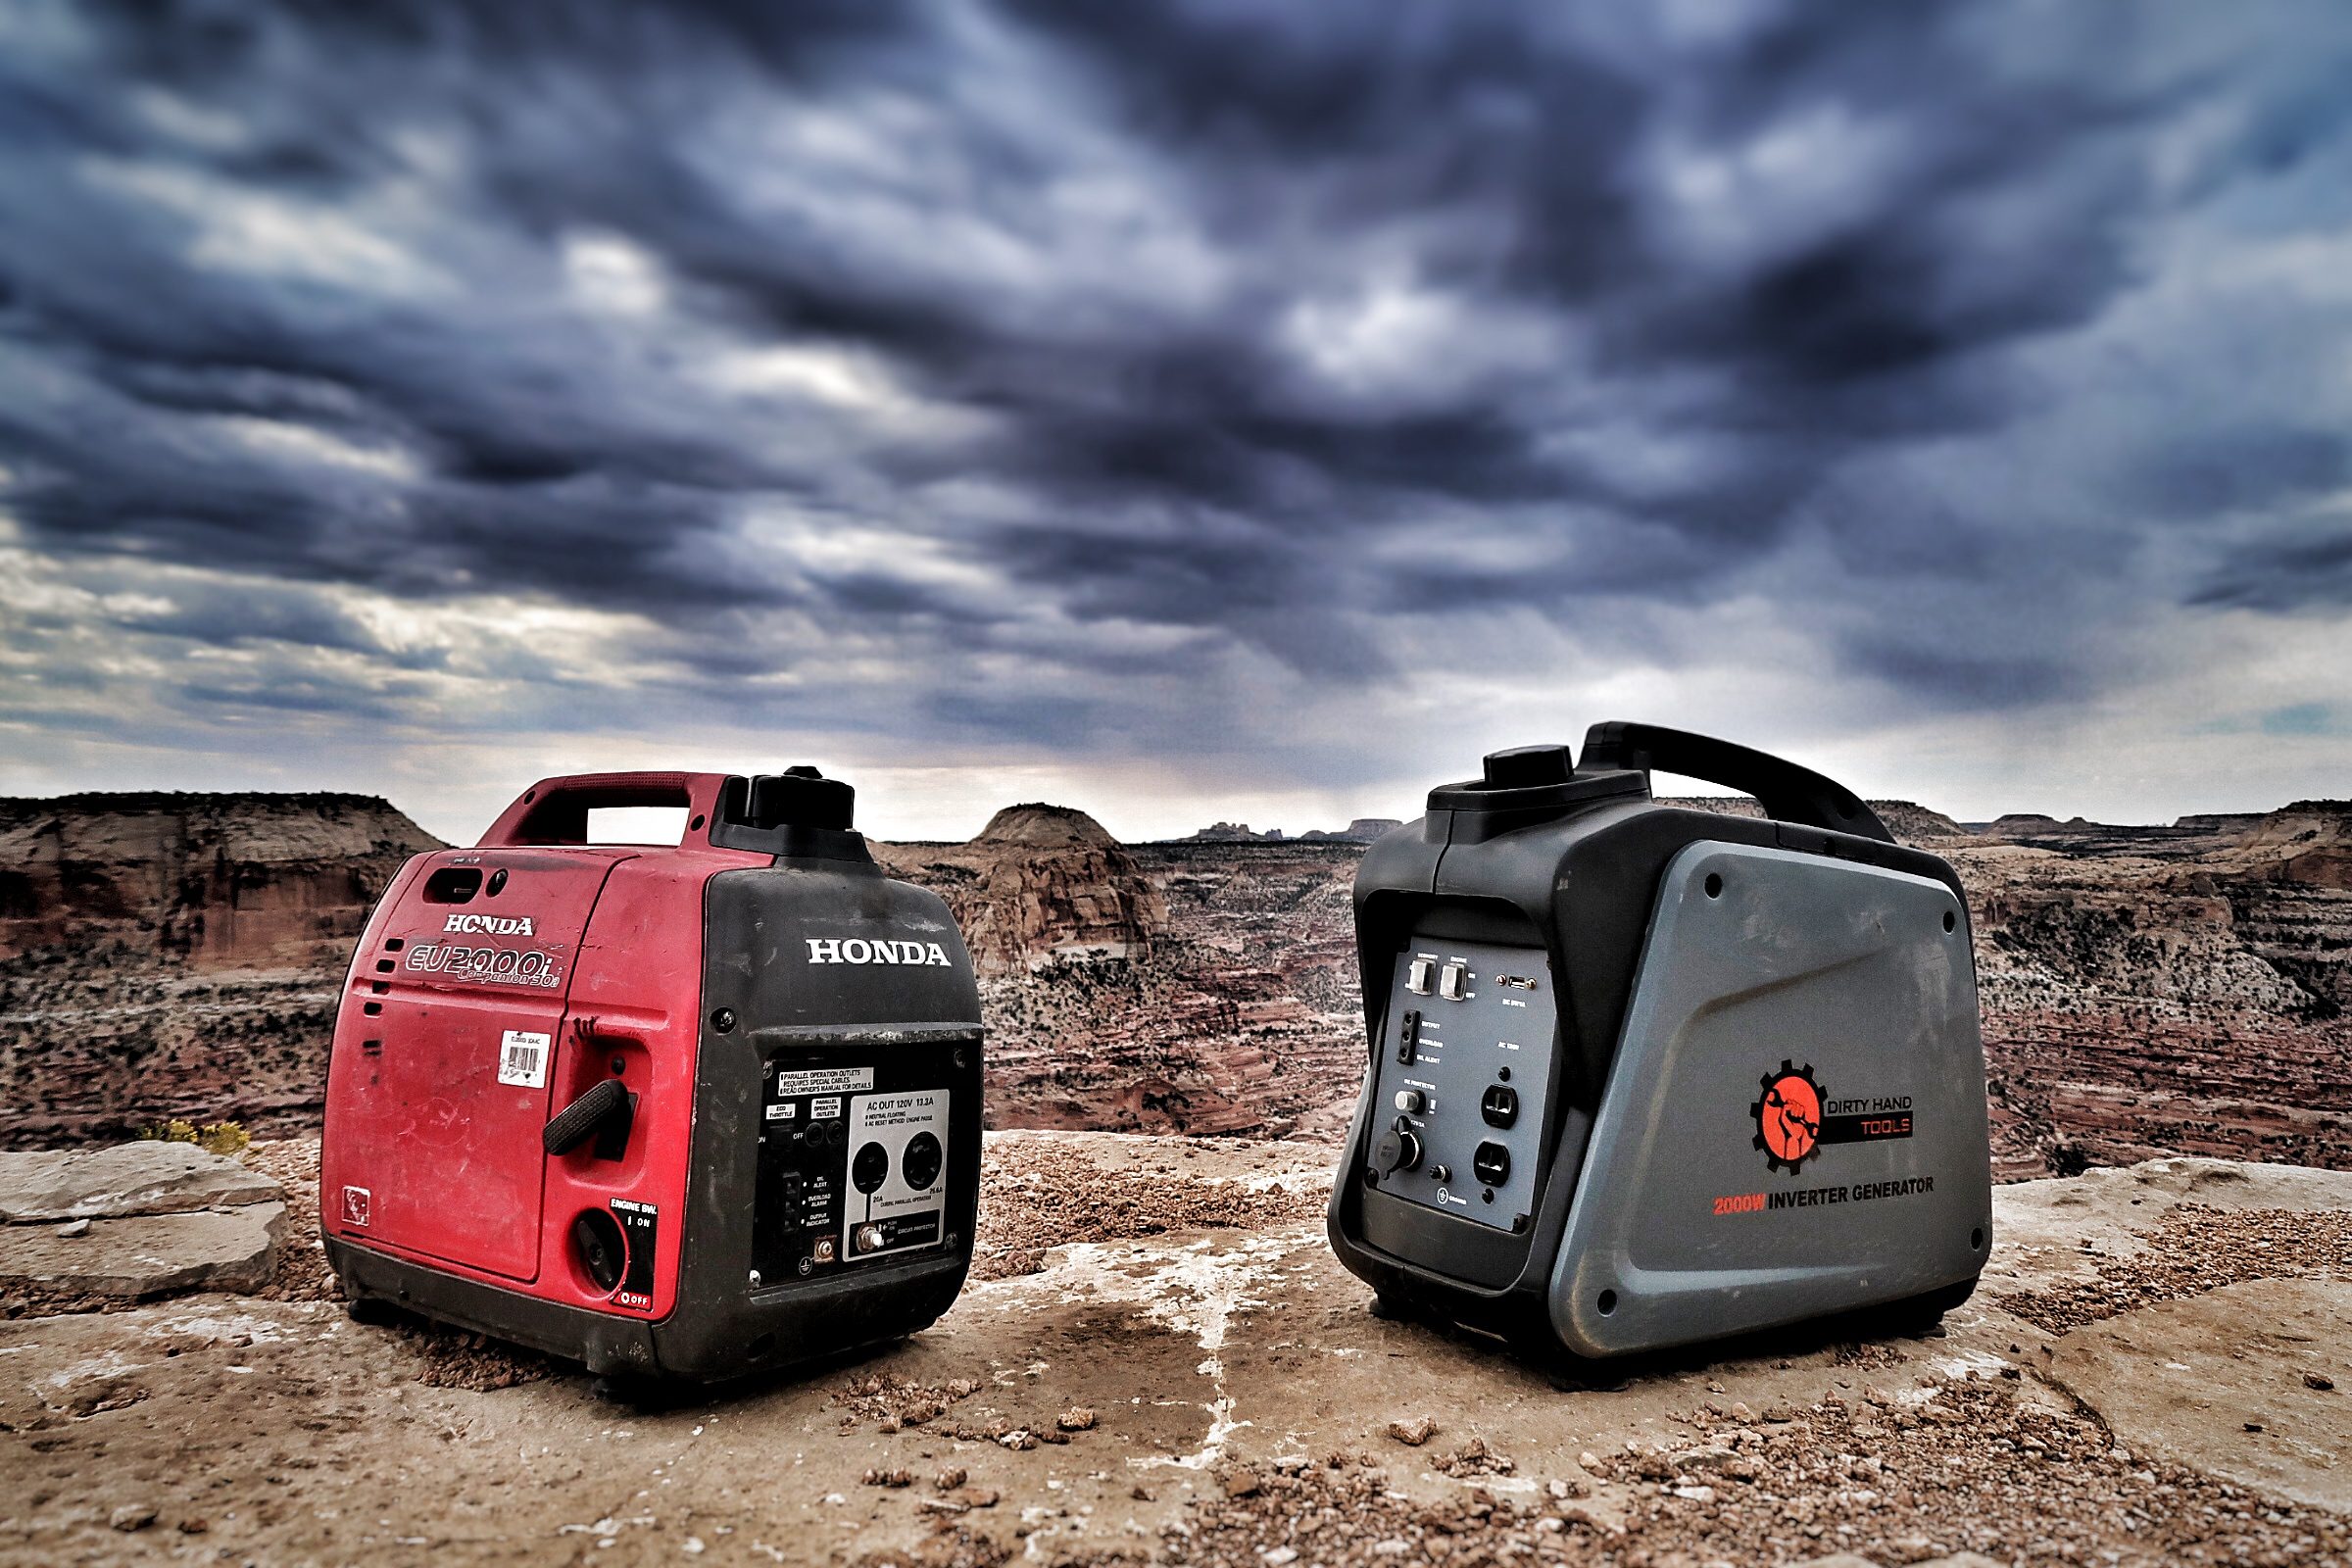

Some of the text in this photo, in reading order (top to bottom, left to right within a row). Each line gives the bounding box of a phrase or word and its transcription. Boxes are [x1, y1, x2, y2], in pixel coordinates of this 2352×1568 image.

[443, 913, 534, 937] HONDA
[805, 938, 953, 967] HONDA
[809, 1070, 839, 1079] OPERATION
[866, 1102, 878, 1111] AC
[878, 1100, 895, 1109] OUT
[896, 1098, 913, 1108] 120V
[1828, 1096, 1912, 1114] DIRTY HAND
[1861, 1118, 1910, 1135] TOOLS
[1713, 1176, 1935, 1216] 2000W INVERTER GENERATOR
[611, 1198, 641, 1212] ENGINE
[637, 1217, 651, 1228] ON
[630, 1295, 648, 1305] OFF
